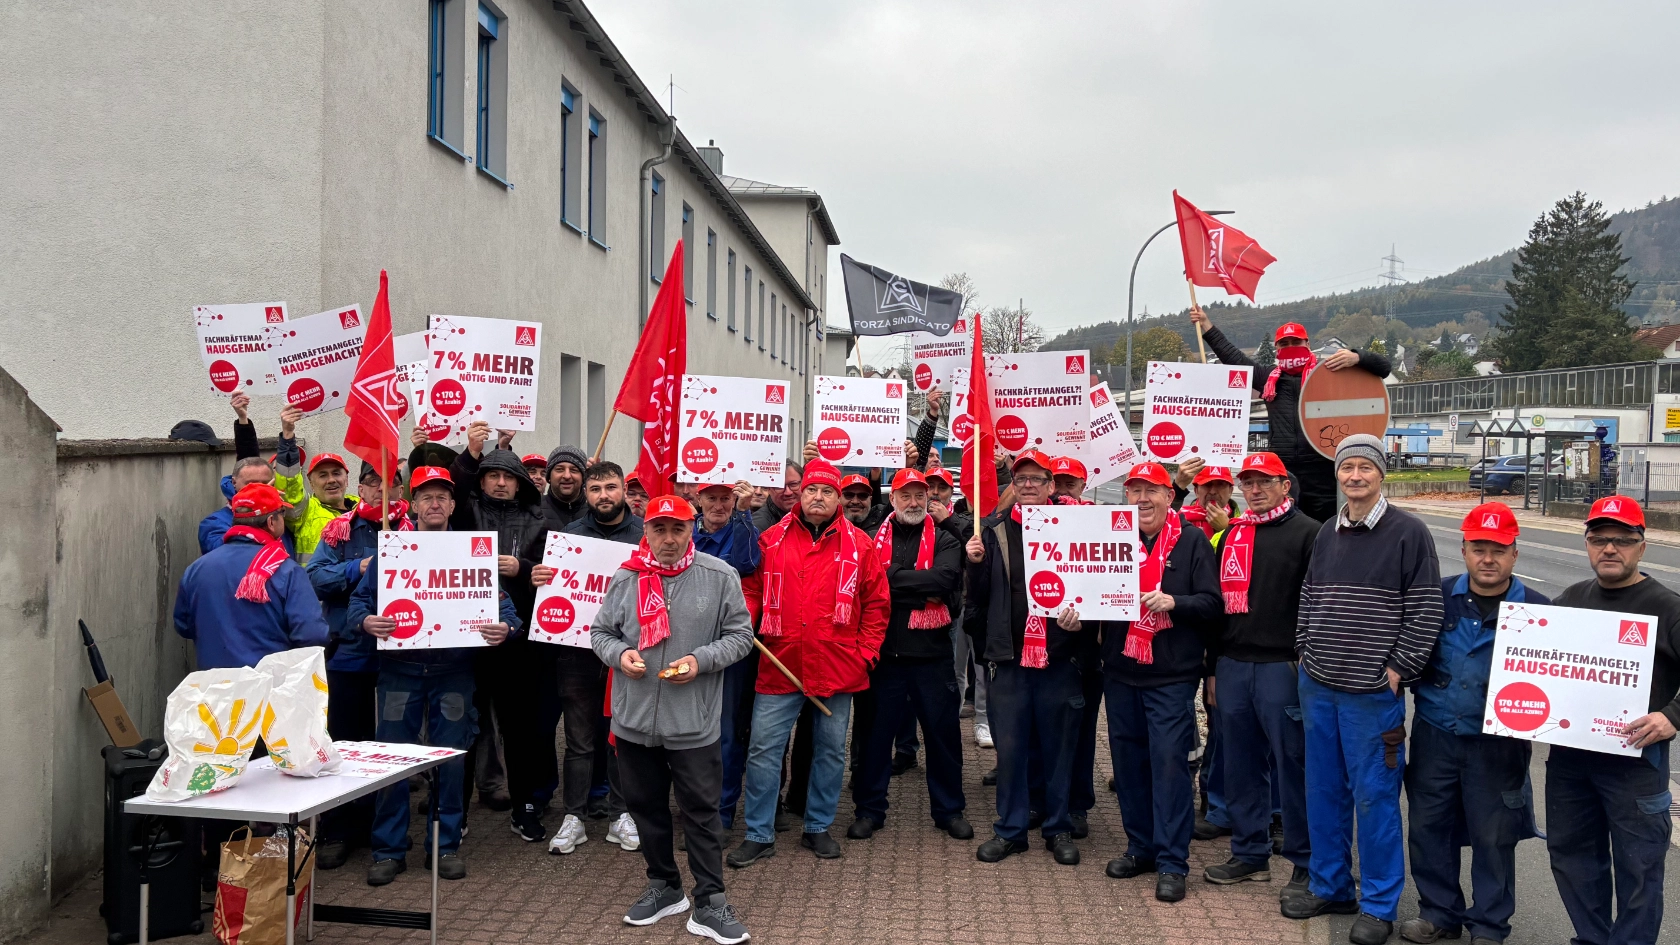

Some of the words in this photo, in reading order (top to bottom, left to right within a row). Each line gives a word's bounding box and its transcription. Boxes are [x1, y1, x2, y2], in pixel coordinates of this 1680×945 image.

[854, 319, 891, 329] FORZA
[892, 315, 950, 330] SINDICATO
[206, 342, 266, 354] HAUSGEMAC
[914, 348, 966, 359] HAUSGEMACHT!
[472, 353, 534, 376] MEHR
[459, 372, 486, 383] NÖTIG
[488, 375, 507, 384] UND
[509, 377, 532, 386] FAIR!
[994, 386, 1082, 396] FACHKRÄFTEMANGEL?!
[995, 395, 1082, 408] HAUSGEMACHT!
[1153, 395, 1242, 407] FACHKRÄFTEMANGEL?!
[821, 404, 900, 414] FACHKRÄFTEMANGEL?!
[1152, 405, 1242, 419] HAUSGEMACHT!
[724, 411, 783, 433] MEHR
[821, 412, 900, 424] HAUSGEMACHT!
[712, 430, 738, 440] NÖTIG
[740, 433, 758, 442] UND
[760, 435, 782, 443] FAIR!
[1068, 543, 1134, 562] MEHR
[1056, 563, 1084, 573] NÖTIG
[1087, 565, 1106, 573] UND
[1109, 565, 1133, 573] FAIR!
[428, 568, 492, 588] MEHR
[414, 590, 443, 600] NÖTIG
[446, 592, 466, 600] UND
[468, 590, 492, 599] FAIR!
[570, 591, 597, 603] NÖTIG
[394, 612, 409, 620] 170
[549, 608, 562, 616] 170
[1505, 646, 1640, 671] FACHKRÄFTEMANGEL?!
[1504, 658, 1639, 688] HAUSGEMACHT!
[1514, 699, 1520, 707] €
[1522, 700, 1546, 709] MEHR
